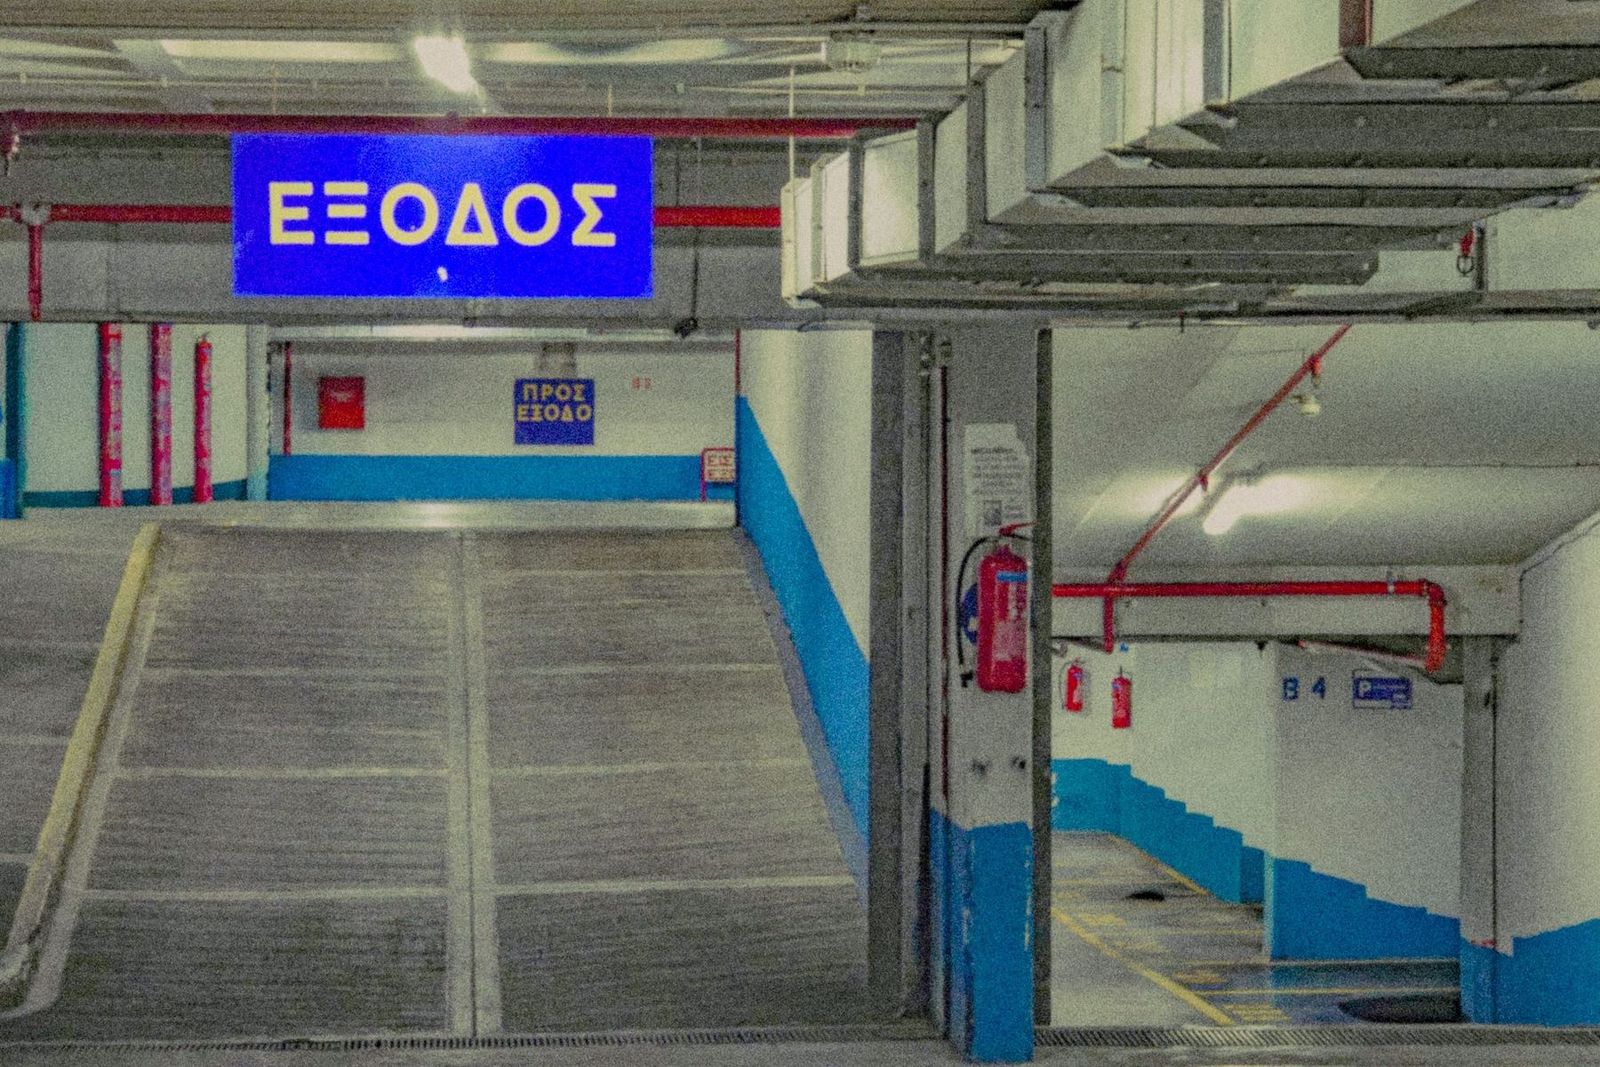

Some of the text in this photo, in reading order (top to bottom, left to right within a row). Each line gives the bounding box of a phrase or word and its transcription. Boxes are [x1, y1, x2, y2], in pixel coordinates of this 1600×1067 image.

[268, 181, 618, 246] ΕΞΟΔΟΣ
[522, 383, 585, 401] ΠΡΟΣ
[517, 403, 592, 422] ΕΞΟΔΟ
